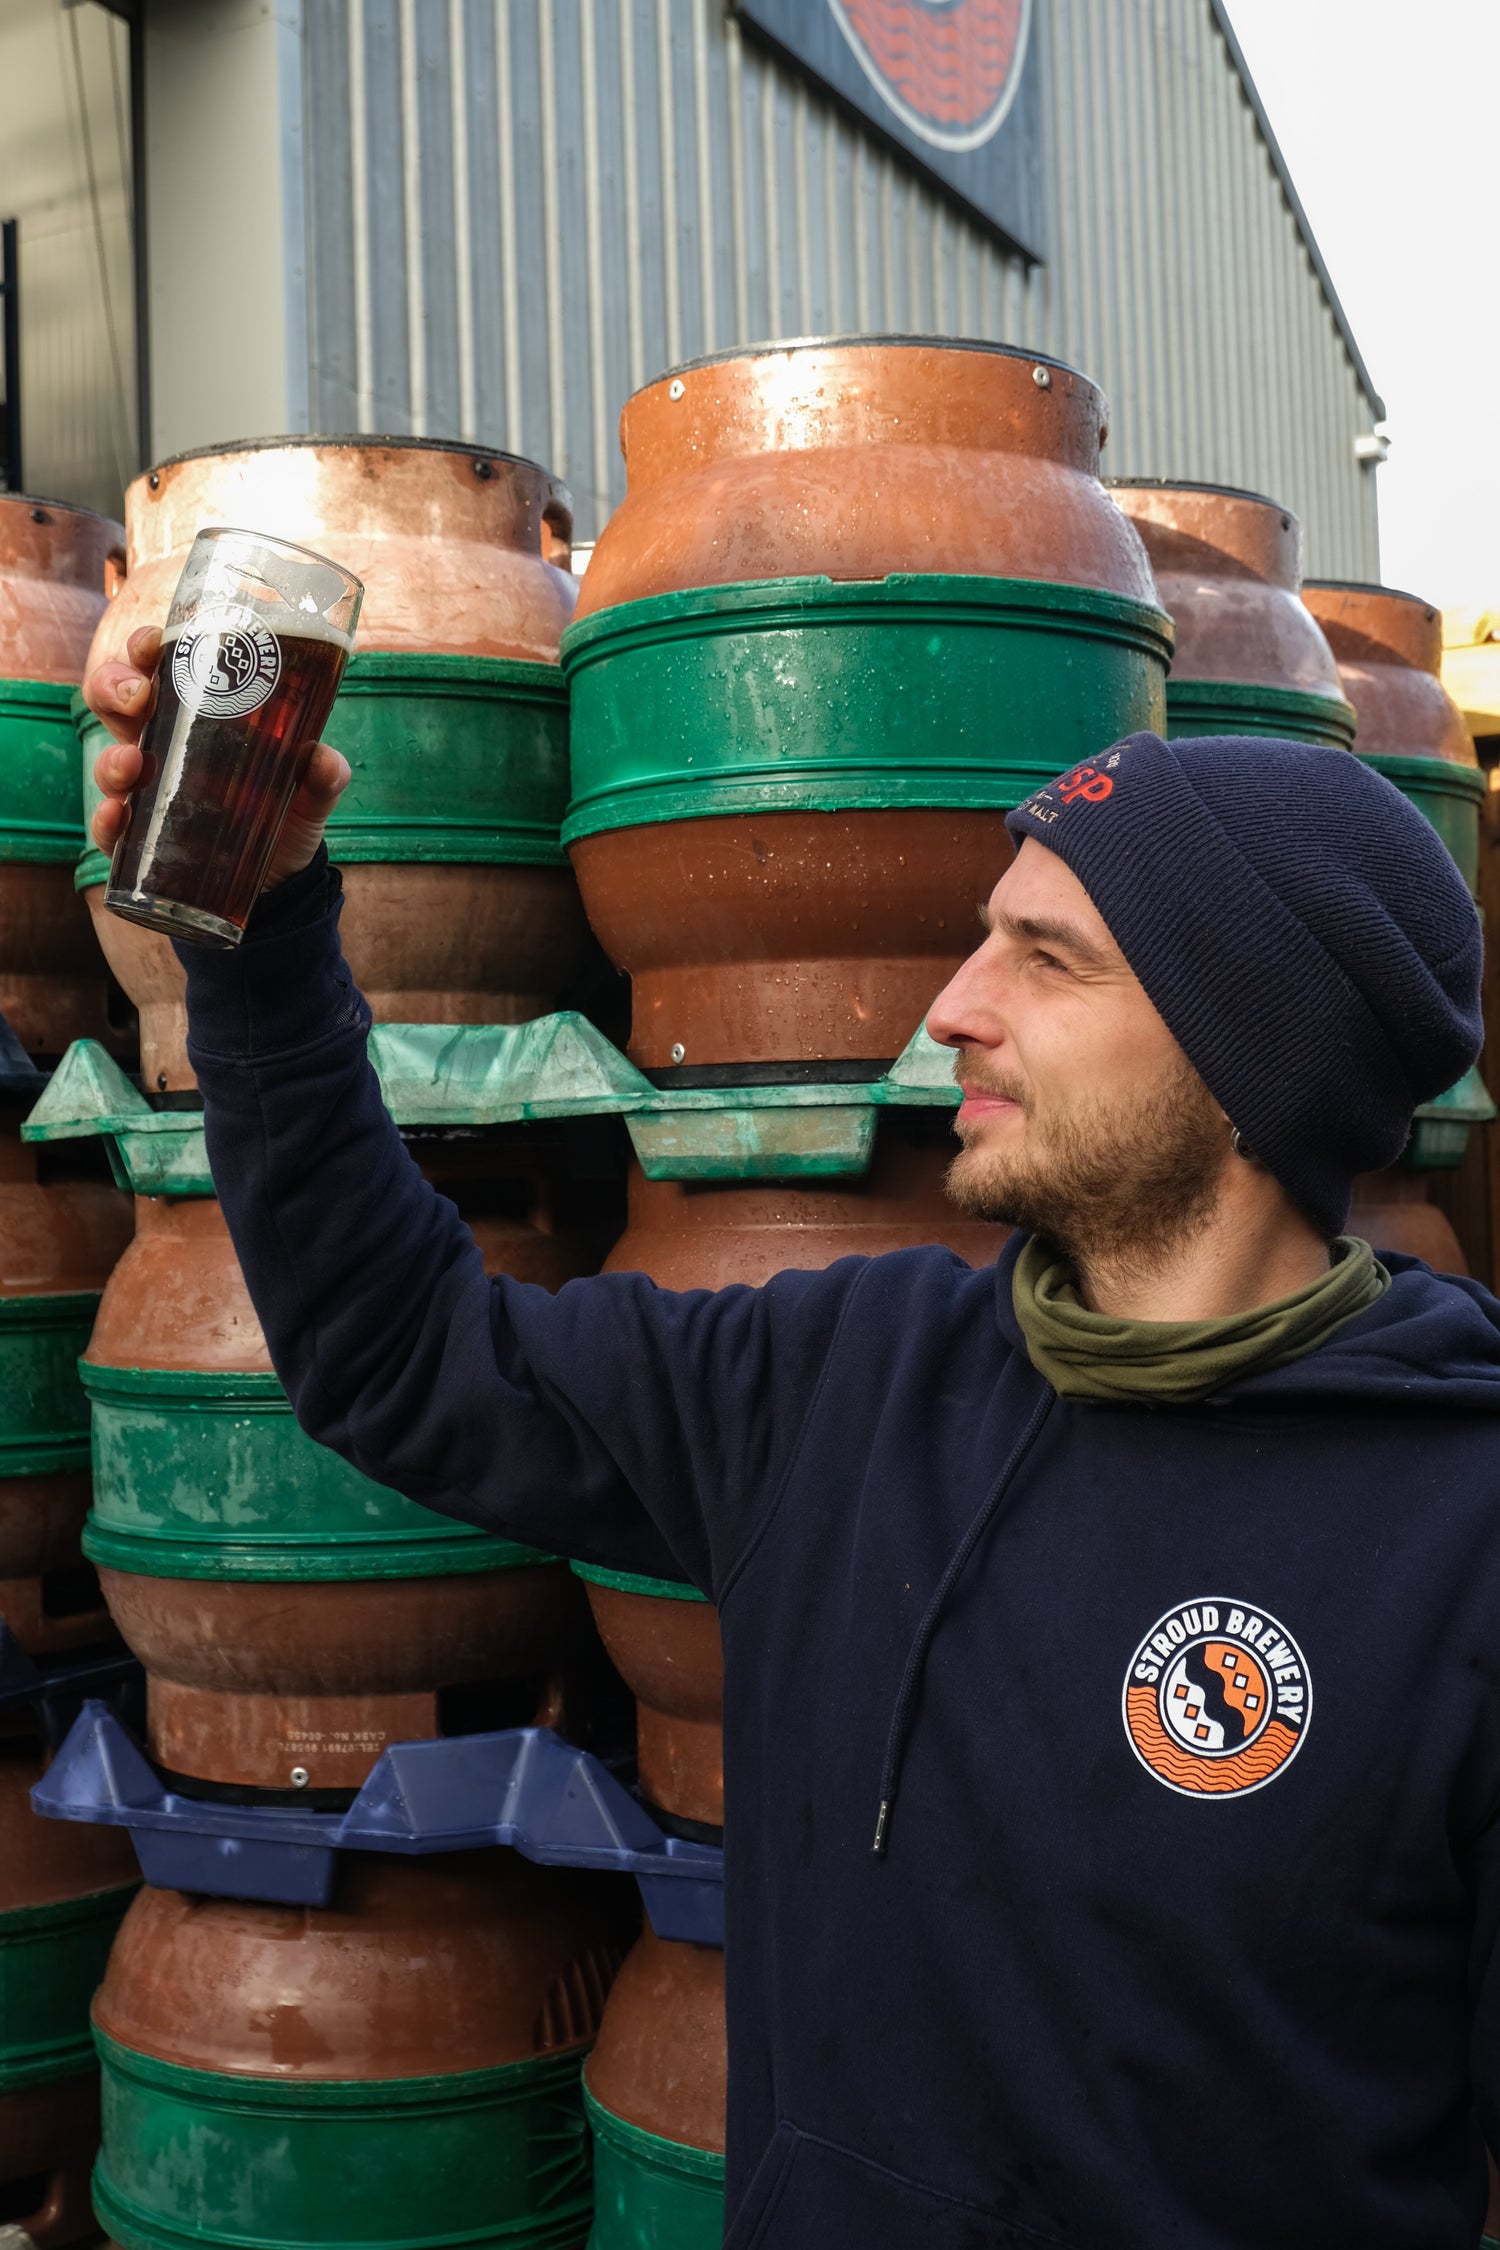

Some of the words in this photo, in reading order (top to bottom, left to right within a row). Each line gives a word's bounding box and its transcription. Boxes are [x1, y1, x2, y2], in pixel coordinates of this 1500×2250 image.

[1028, 803, 1059, 824] MALT
[1134, 1606, 1219, 1683] STROUD
[1225, 1608, 1304, 1725] BREWERY
[353, 1731, 387, 1741] CASK
